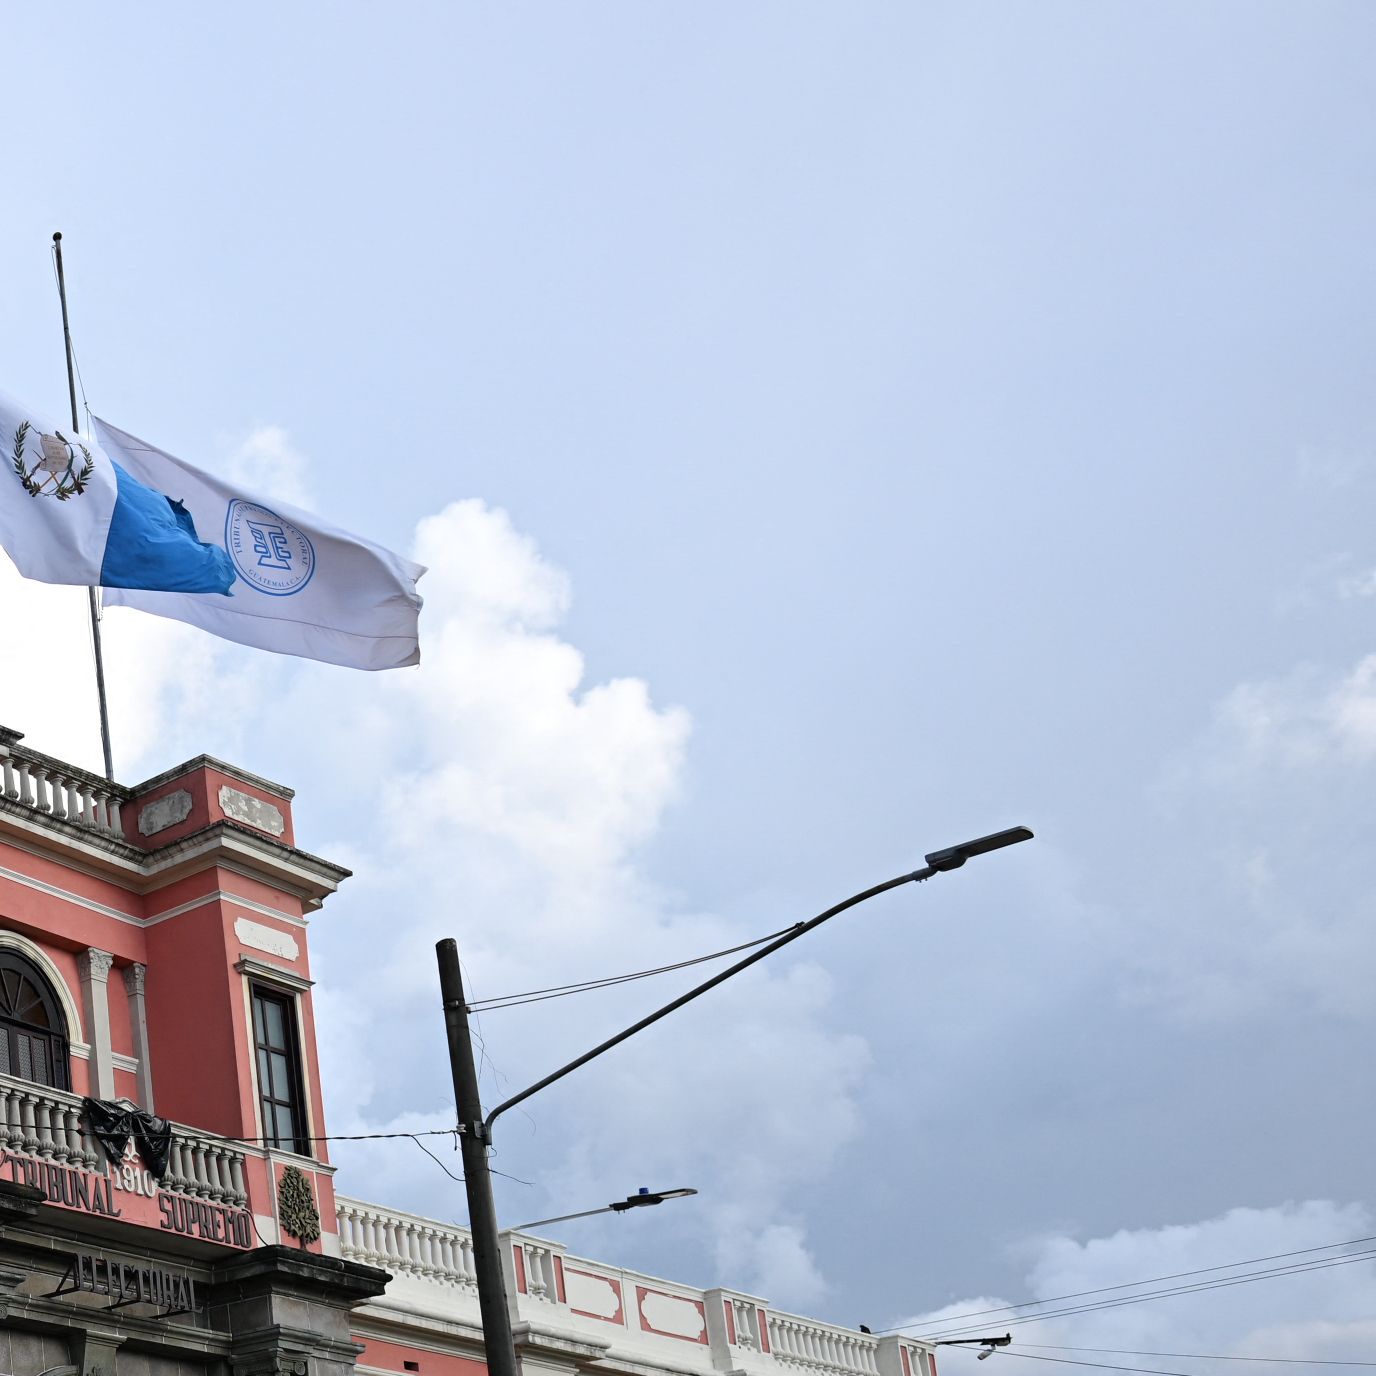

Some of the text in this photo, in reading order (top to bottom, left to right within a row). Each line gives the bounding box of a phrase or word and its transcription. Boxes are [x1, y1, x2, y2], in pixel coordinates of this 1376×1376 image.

[4, 1156, 252, 1249] TRIBUNAL SUPREMO
[113, 1164, 156, 1198] 1910
[77, 1254, 203, 1314] ELECTORAL
